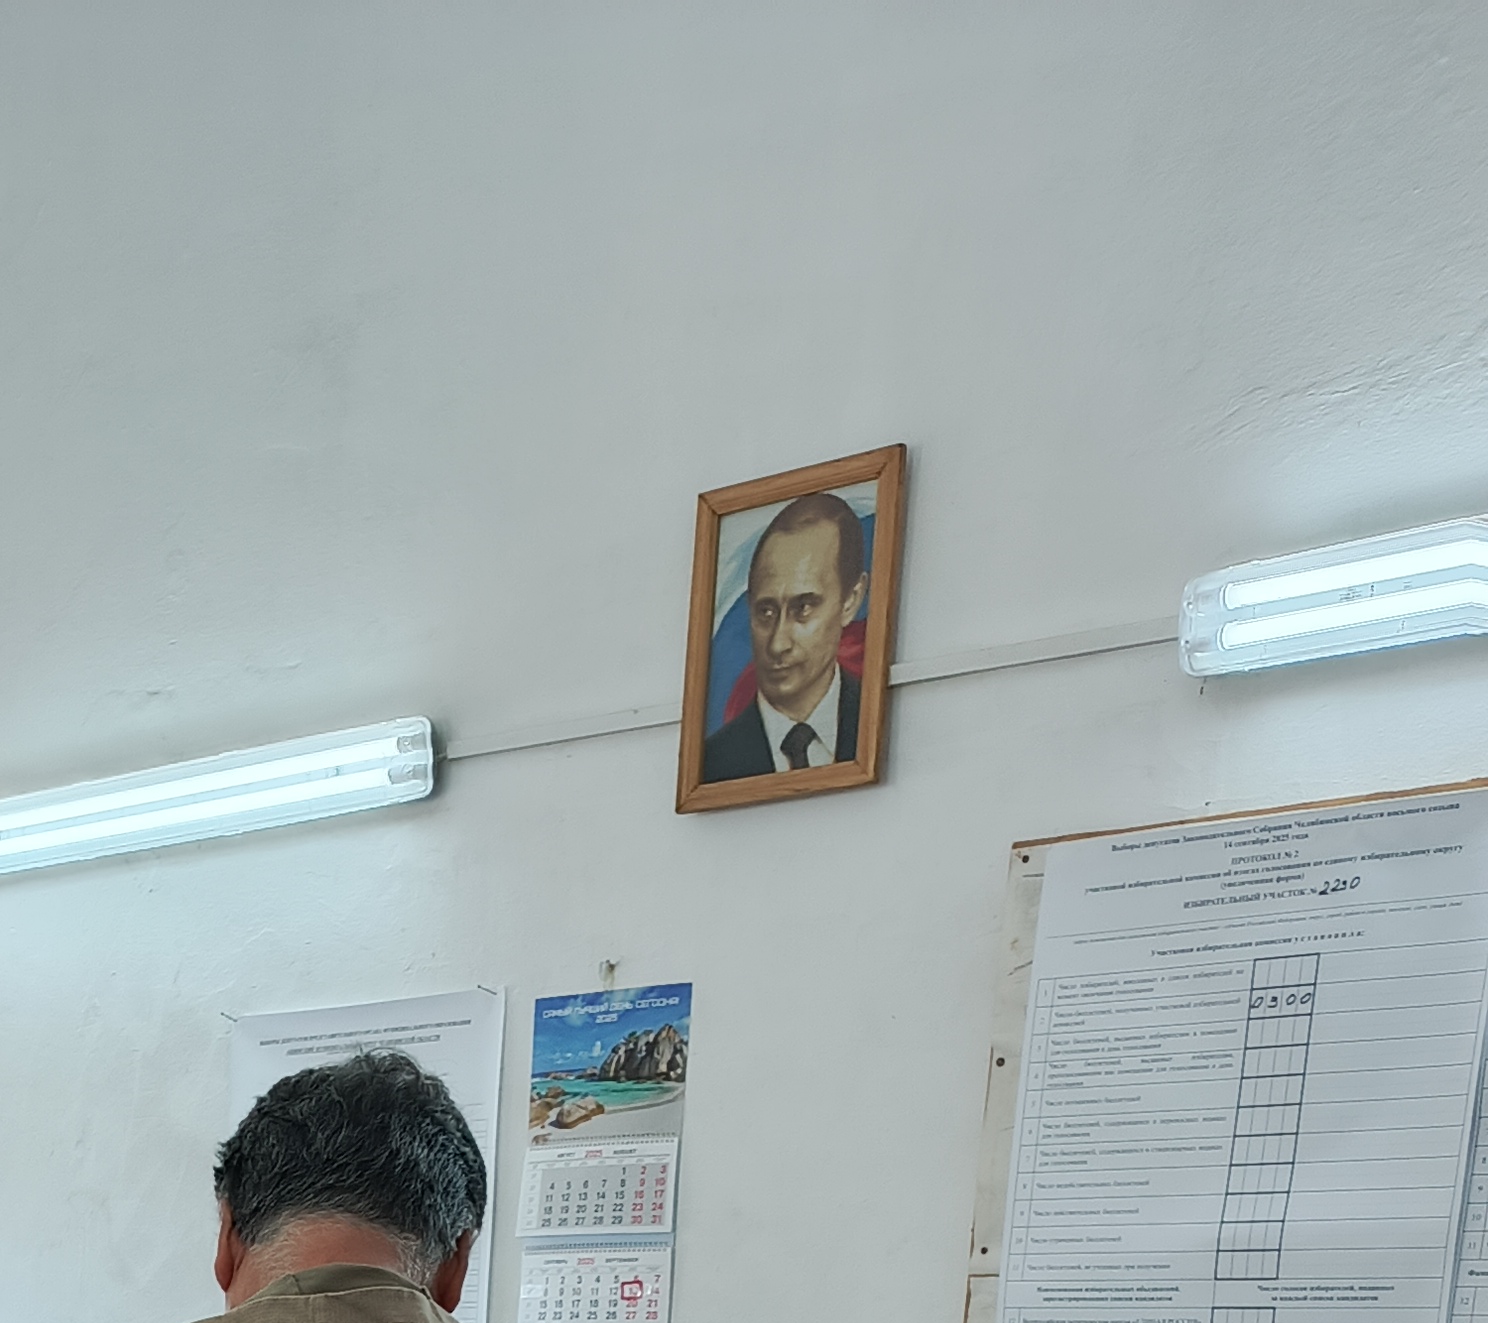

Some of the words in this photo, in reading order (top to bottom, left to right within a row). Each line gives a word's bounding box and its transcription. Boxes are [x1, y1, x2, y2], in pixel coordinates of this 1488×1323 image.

[640, 1166, 647, 1175] 2
[549, 1182, 554, 1190] 4
[583, 1180, 589, 1189] 6
[602, 1179, 607, 1188] 7
[620, 1178, 626, 1187] 8
[546, 1194, 553, 1202] 11
[561, 1193, 570, 1202] 12
[579, 1192, 588, 1201] 13
[597, 1192, 605, 1200] 14
[615, 1191, 625, 1199] 15
[655, 1190, 665, 1198] 17
[576, 1205, 586, 1213] 20
[594, 1204, 604, 1213] 21
[612, 1203, 624, 1212] 22
[632, 1203, 643, 1212] 23
[651, 1202, 664, 1211] 24
[575, 1217, 586, 1226] 27
[592, 1216, 604, 1225] 28
[611, 1216, 623, 1224] 29
[631, 1215, 642, 1224] 30
[651, 1214, 662, 1223] 31
[577, 1275, 582, 1284] 3
[594, 1275, 601, 1283] 4
[613, 1275, 619, 1283] 5
[654, 1274, 661, 1283] 7
[591, 1287, 599, 1296] 11
[572, 1299, 581, 1308] 17
[608, 1299, 618, 1307] 19
[647, 1299, 658, 1307] 21
[538, 1312, 546, 1321] 22
[552, 1311, 562, 1320] 23
[569, 1311, 580, 1320] 24
[587, 1311, 597, 1320] 25
[625, 1311, 637, 1320] 27
